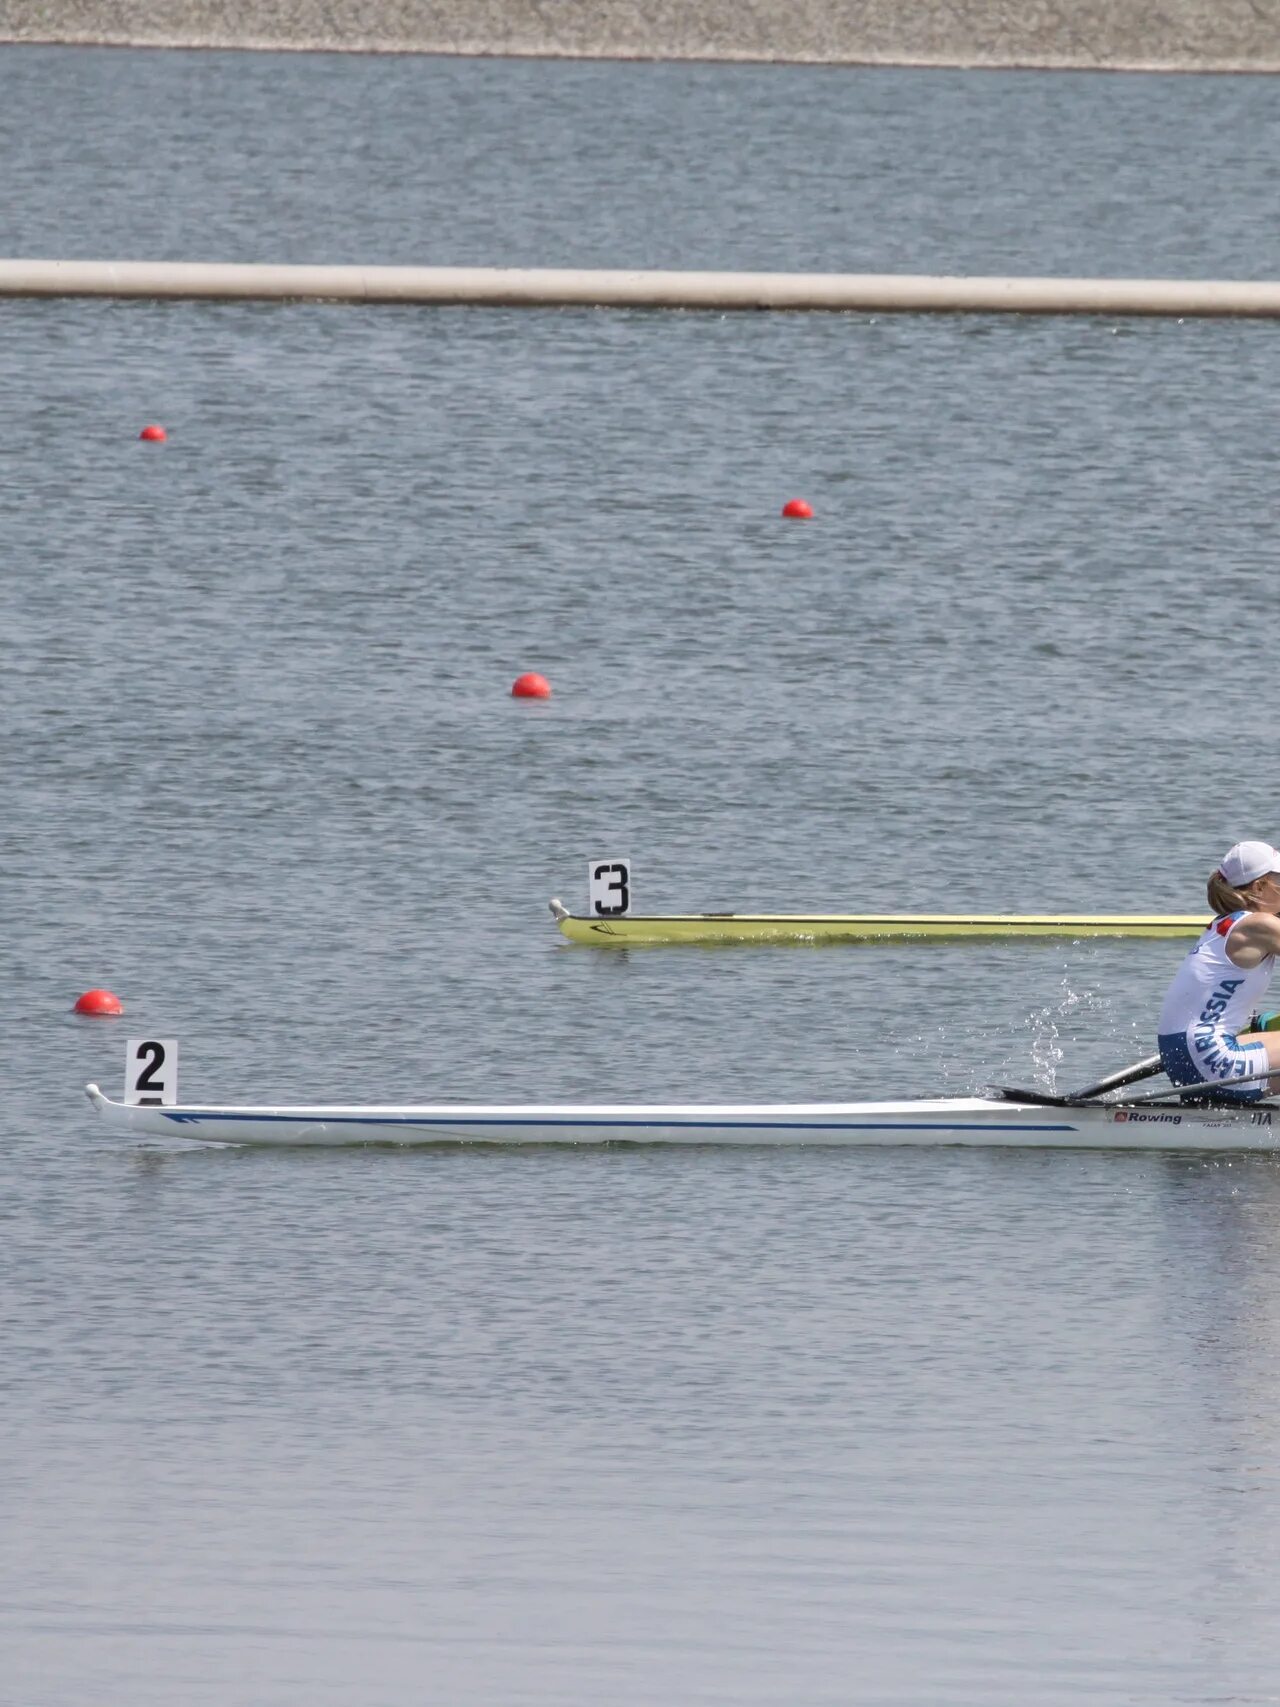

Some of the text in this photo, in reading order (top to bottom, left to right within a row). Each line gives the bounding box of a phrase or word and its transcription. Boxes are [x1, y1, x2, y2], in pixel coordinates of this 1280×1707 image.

[594, 864, 628, 915] 3
[1194, 979, 1246, 1053] RUSSIA
[135, 1041, 165, 1091] 2
[1129, 1112, 1182, 1125] Rowing
